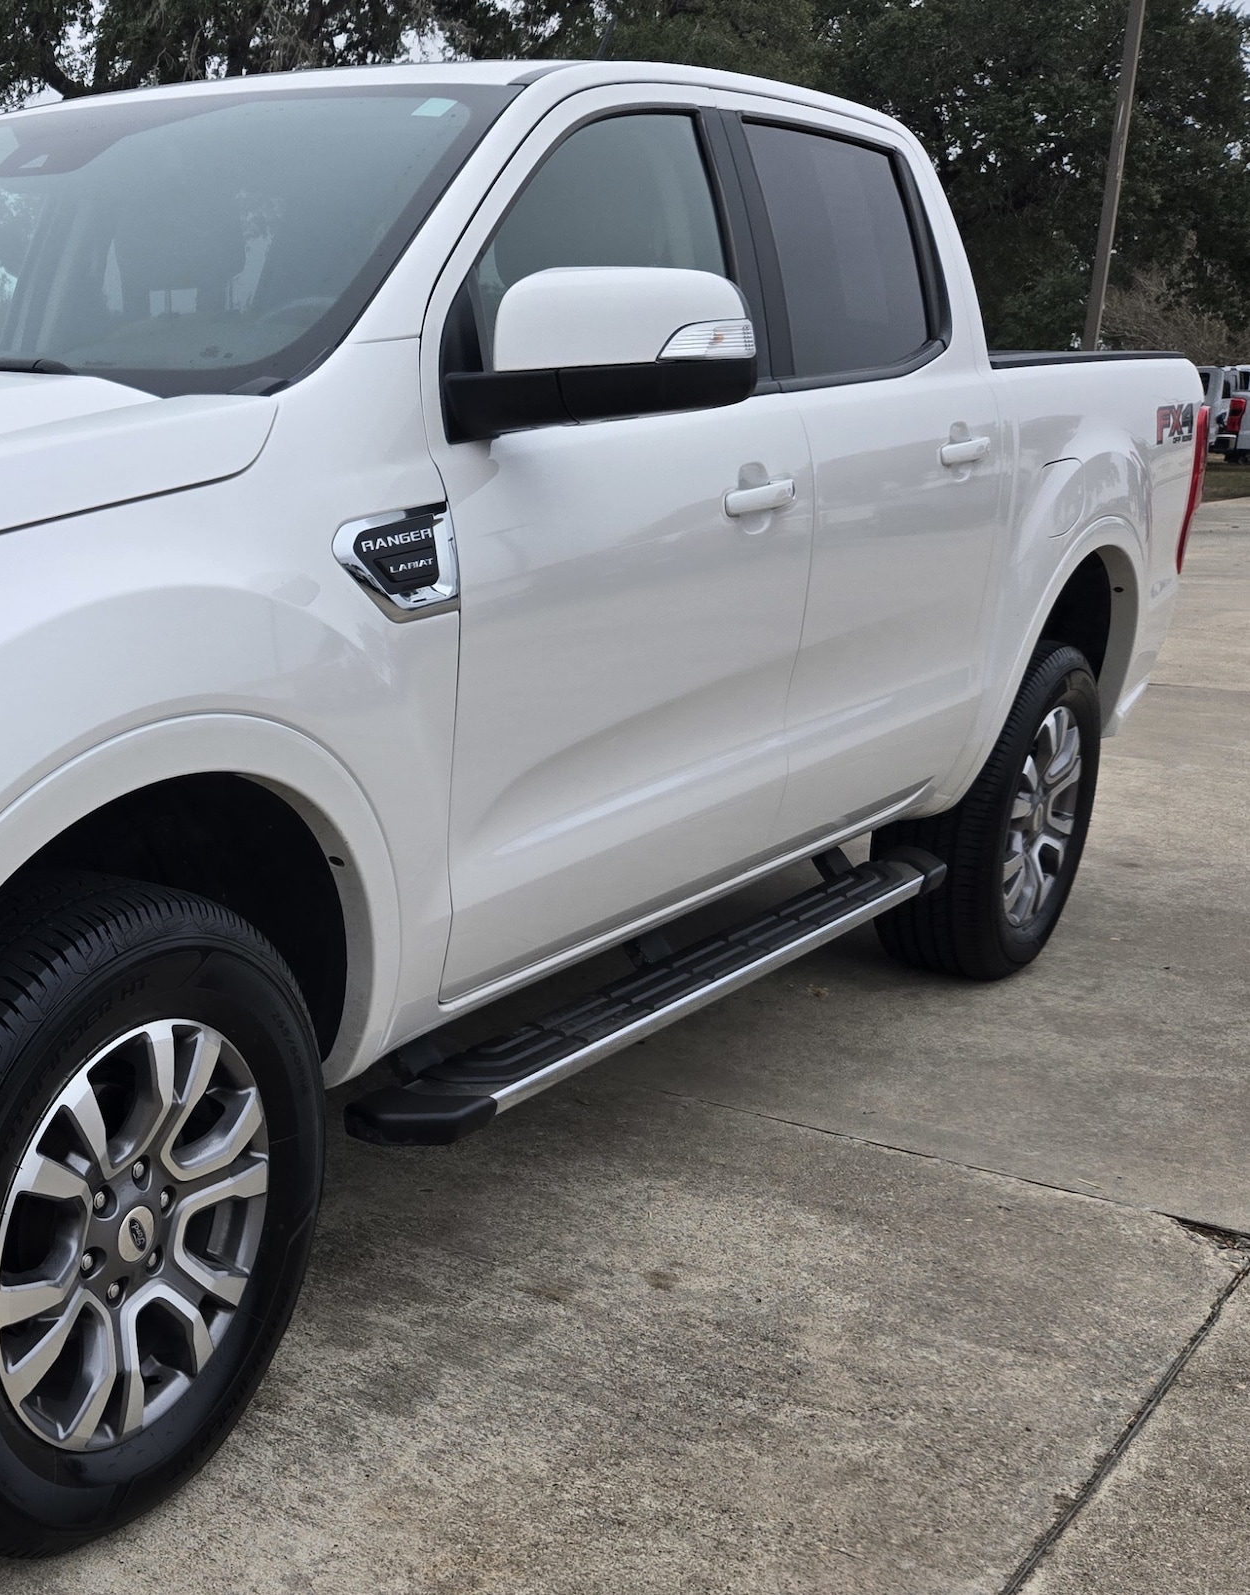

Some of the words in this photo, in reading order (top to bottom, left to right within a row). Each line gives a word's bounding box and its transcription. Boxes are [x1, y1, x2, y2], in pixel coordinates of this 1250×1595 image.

[1156, 403, 1193, 445] FX4
[361, 528, 432, 552] RANGER
[389, 558, 434, 573] LARIAT
[130, 1222, 145, 1246] Ford
